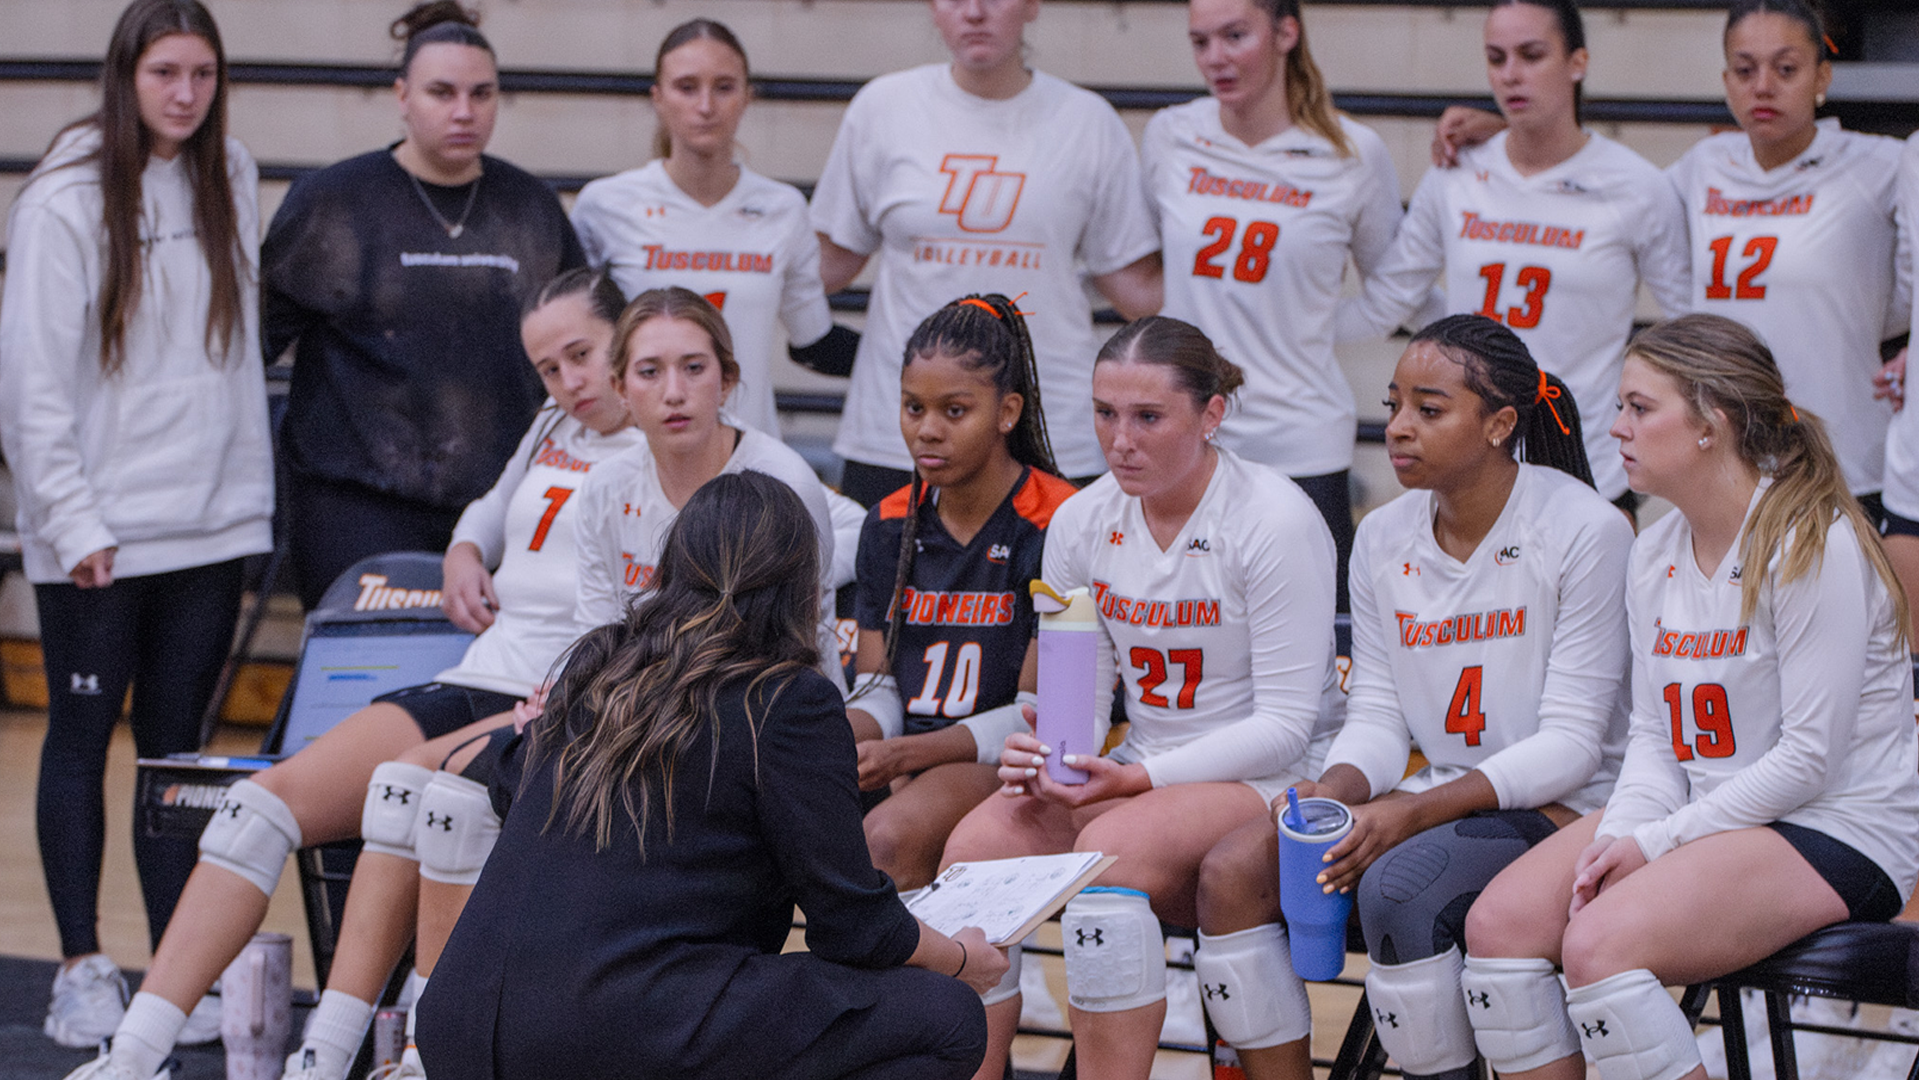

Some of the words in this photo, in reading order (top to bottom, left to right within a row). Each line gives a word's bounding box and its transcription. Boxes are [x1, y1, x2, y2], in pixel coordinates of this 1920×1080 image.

[938, 152, 1026, 233] TU
[1187, 166, 1313, 208] TUSCULUM
[640, 243, 773, 274] TUSCULUM
[1192, 216, 1280, 284] 28
[1459, 210, 1585, 249] TUSCULUM
[1472, 262, 1553, 330] 13
[1705, 235, 1779, 300] 12
[528, 486, 575, 552] 7
[1092, 577, 1222, 629] TUSCULUM
[1394, 605, 1527, 649] TUSCULUM
[906, 640, 982, 719] 10
[1129, 646, 1203, 710] 27
[1444, 664, 1486, 748] 4
[1663, 681, 1737, 763] 19
